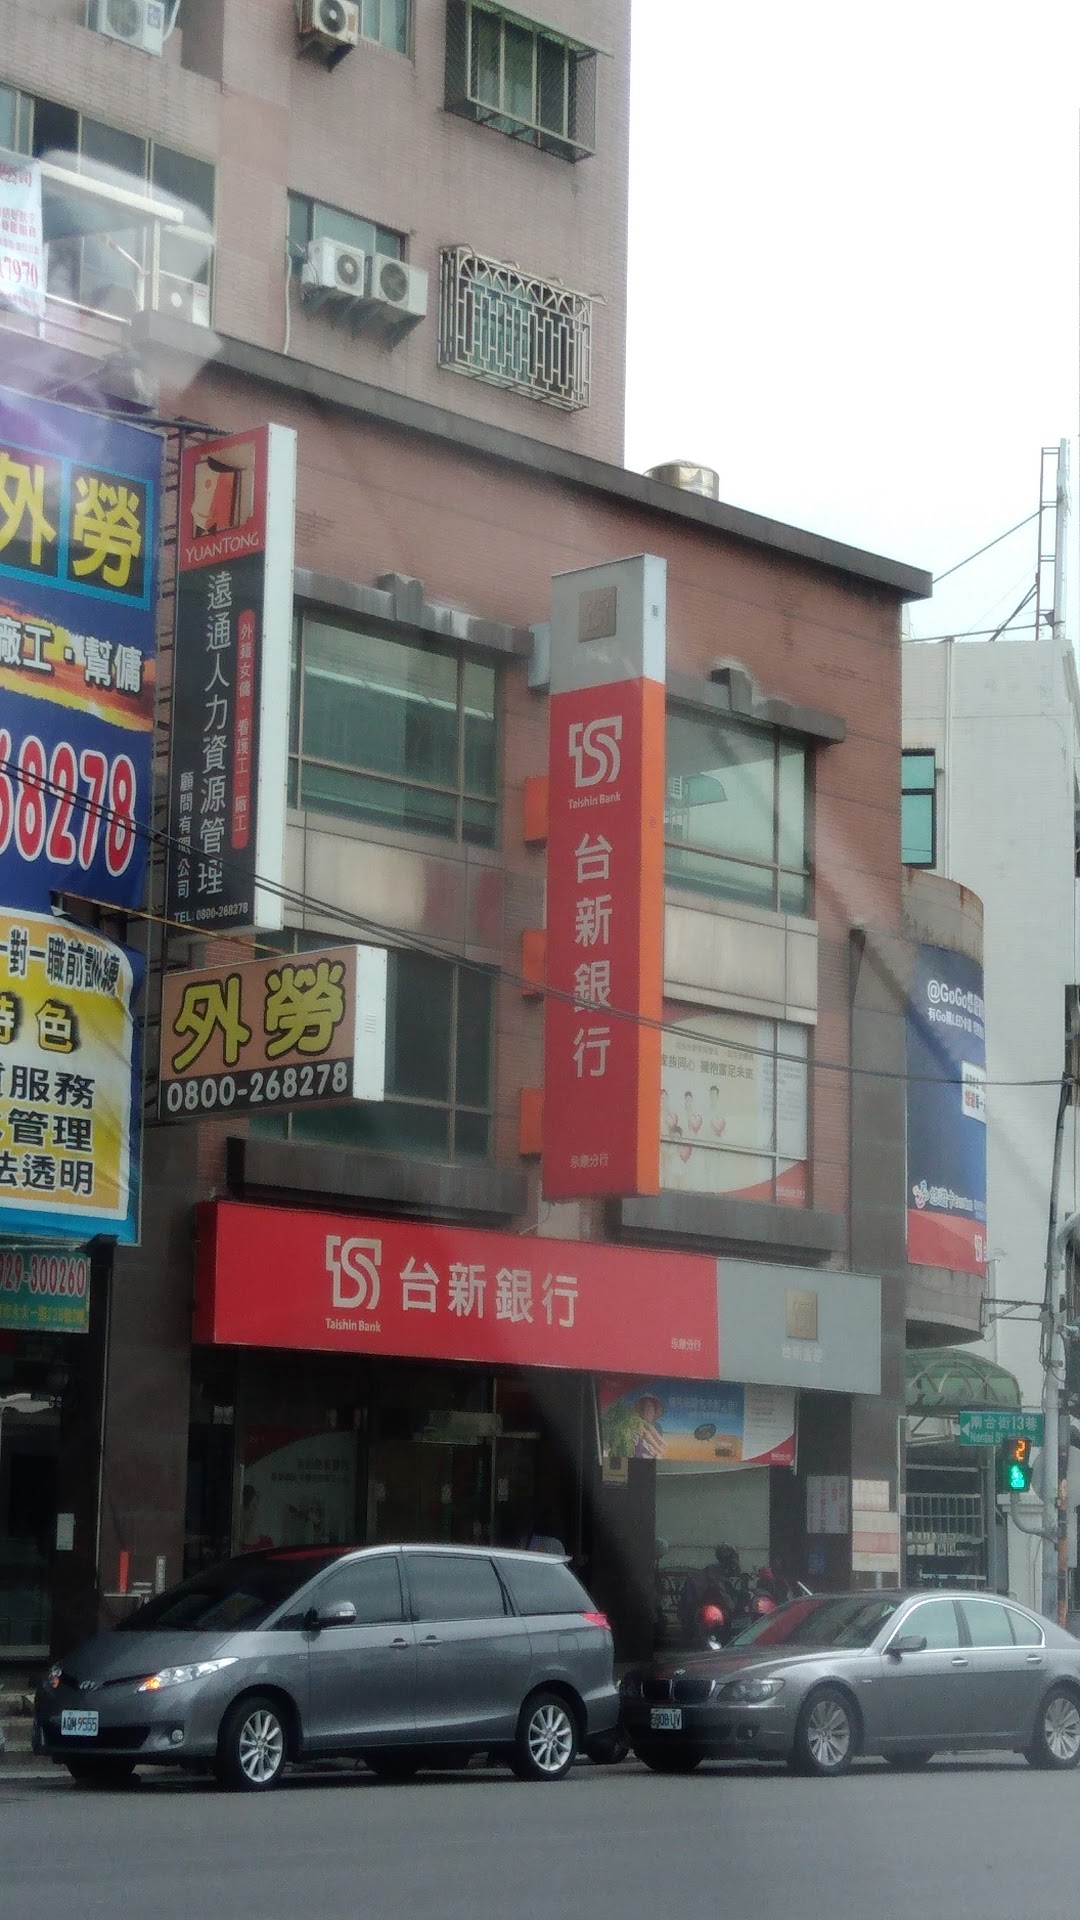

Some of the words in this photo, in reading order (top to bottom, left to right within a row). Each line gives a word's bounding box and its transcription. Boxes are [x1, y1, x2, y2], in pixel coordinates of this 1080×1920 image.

[0, 255, 38, 289] 7970
[0, 452, 142, 588] 外勞
[185, 531, 259, 564] YUANTONG
[197, 570, 233, 895] 遠通人力資源管理
[567, 795, 598, 810] Taishin
[599, 791, 622, 806] Bank
[195, 902, 249, 921] 0800-268278
[573, 833, 613, 1079] 台新銀行
[172, 957, 346, 1074] 外勞
[0, 1063, 96, 1110] 服務
[166, 1062, 348, 1113] 0800-268278
[0, 1107, 93, 1153] 管理
[399, 1256, 579, 1329] 台新銀行
[325, 1317, 356, 1331] Taishin
[358, 1319, 382, 1333] Bank
[1014, 1440, 1027, 1461] 2
